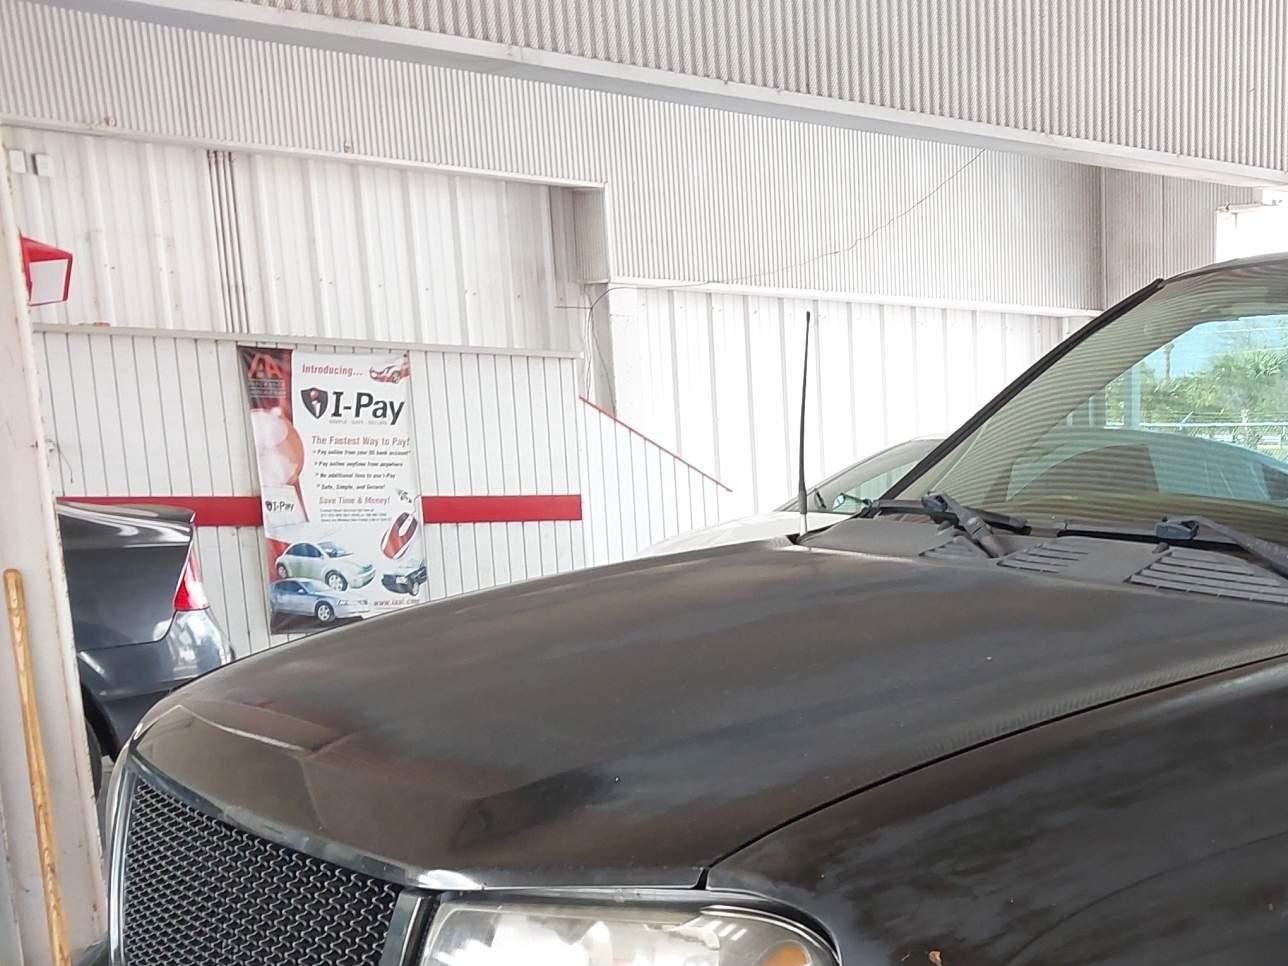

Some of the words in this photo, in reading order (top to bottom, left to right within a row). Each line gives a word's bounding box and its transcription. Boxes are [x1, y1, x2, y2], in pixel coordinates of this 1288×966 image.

[302, 364, 364, 377] Introducing...
[331, 391, 405, 425] I-Pay
[312, 436, 327, 444] The
[329, 436, 360, 445] Fastest
[362, 436, 378, 446] Way
[382, 437, 390, 445] to
[392, 436, 410, 448] Pay!
[274, 501, 294, 512] I-Pay
